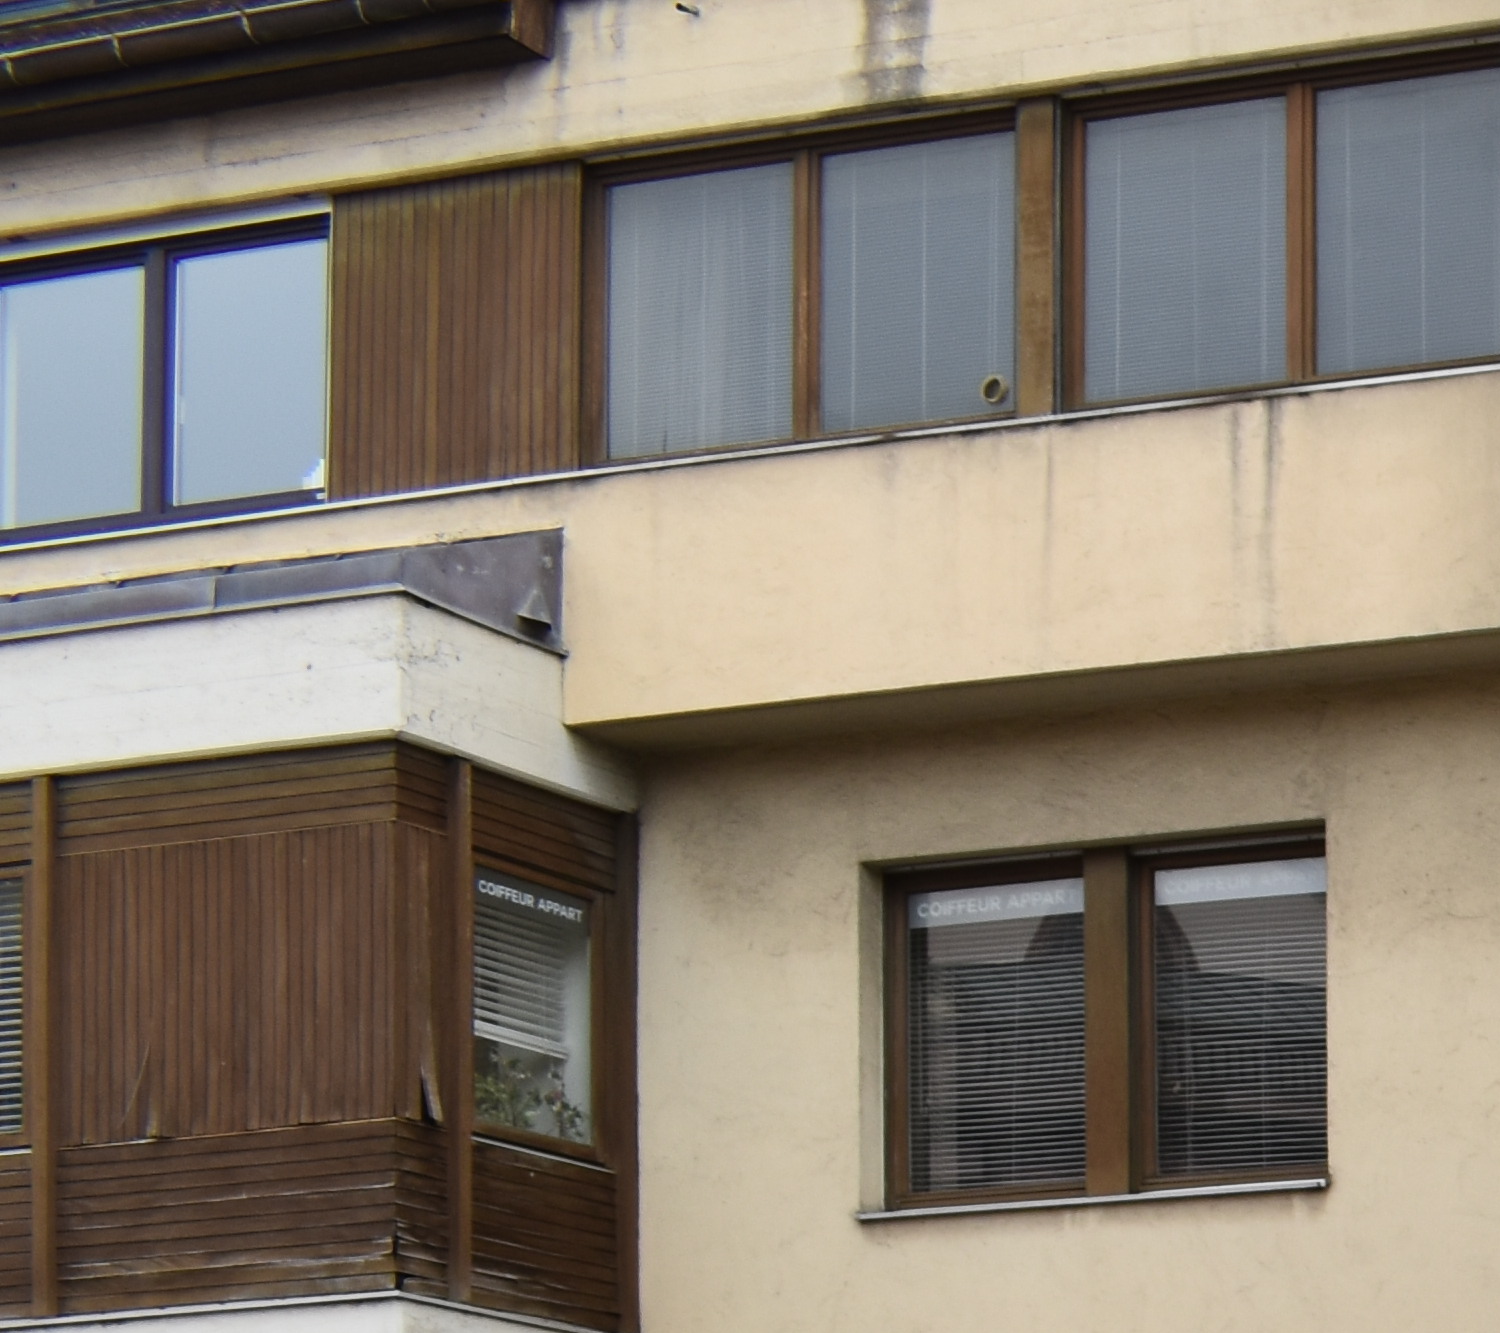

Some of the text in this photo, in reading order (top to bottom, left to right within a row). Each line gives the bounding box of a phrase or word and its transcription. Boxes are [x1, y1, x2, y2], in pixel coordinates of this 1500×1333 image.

[478, 879, 583, 922] COIFFEUR APPART
[916, 895, 1001, 918] COIFFEUR
